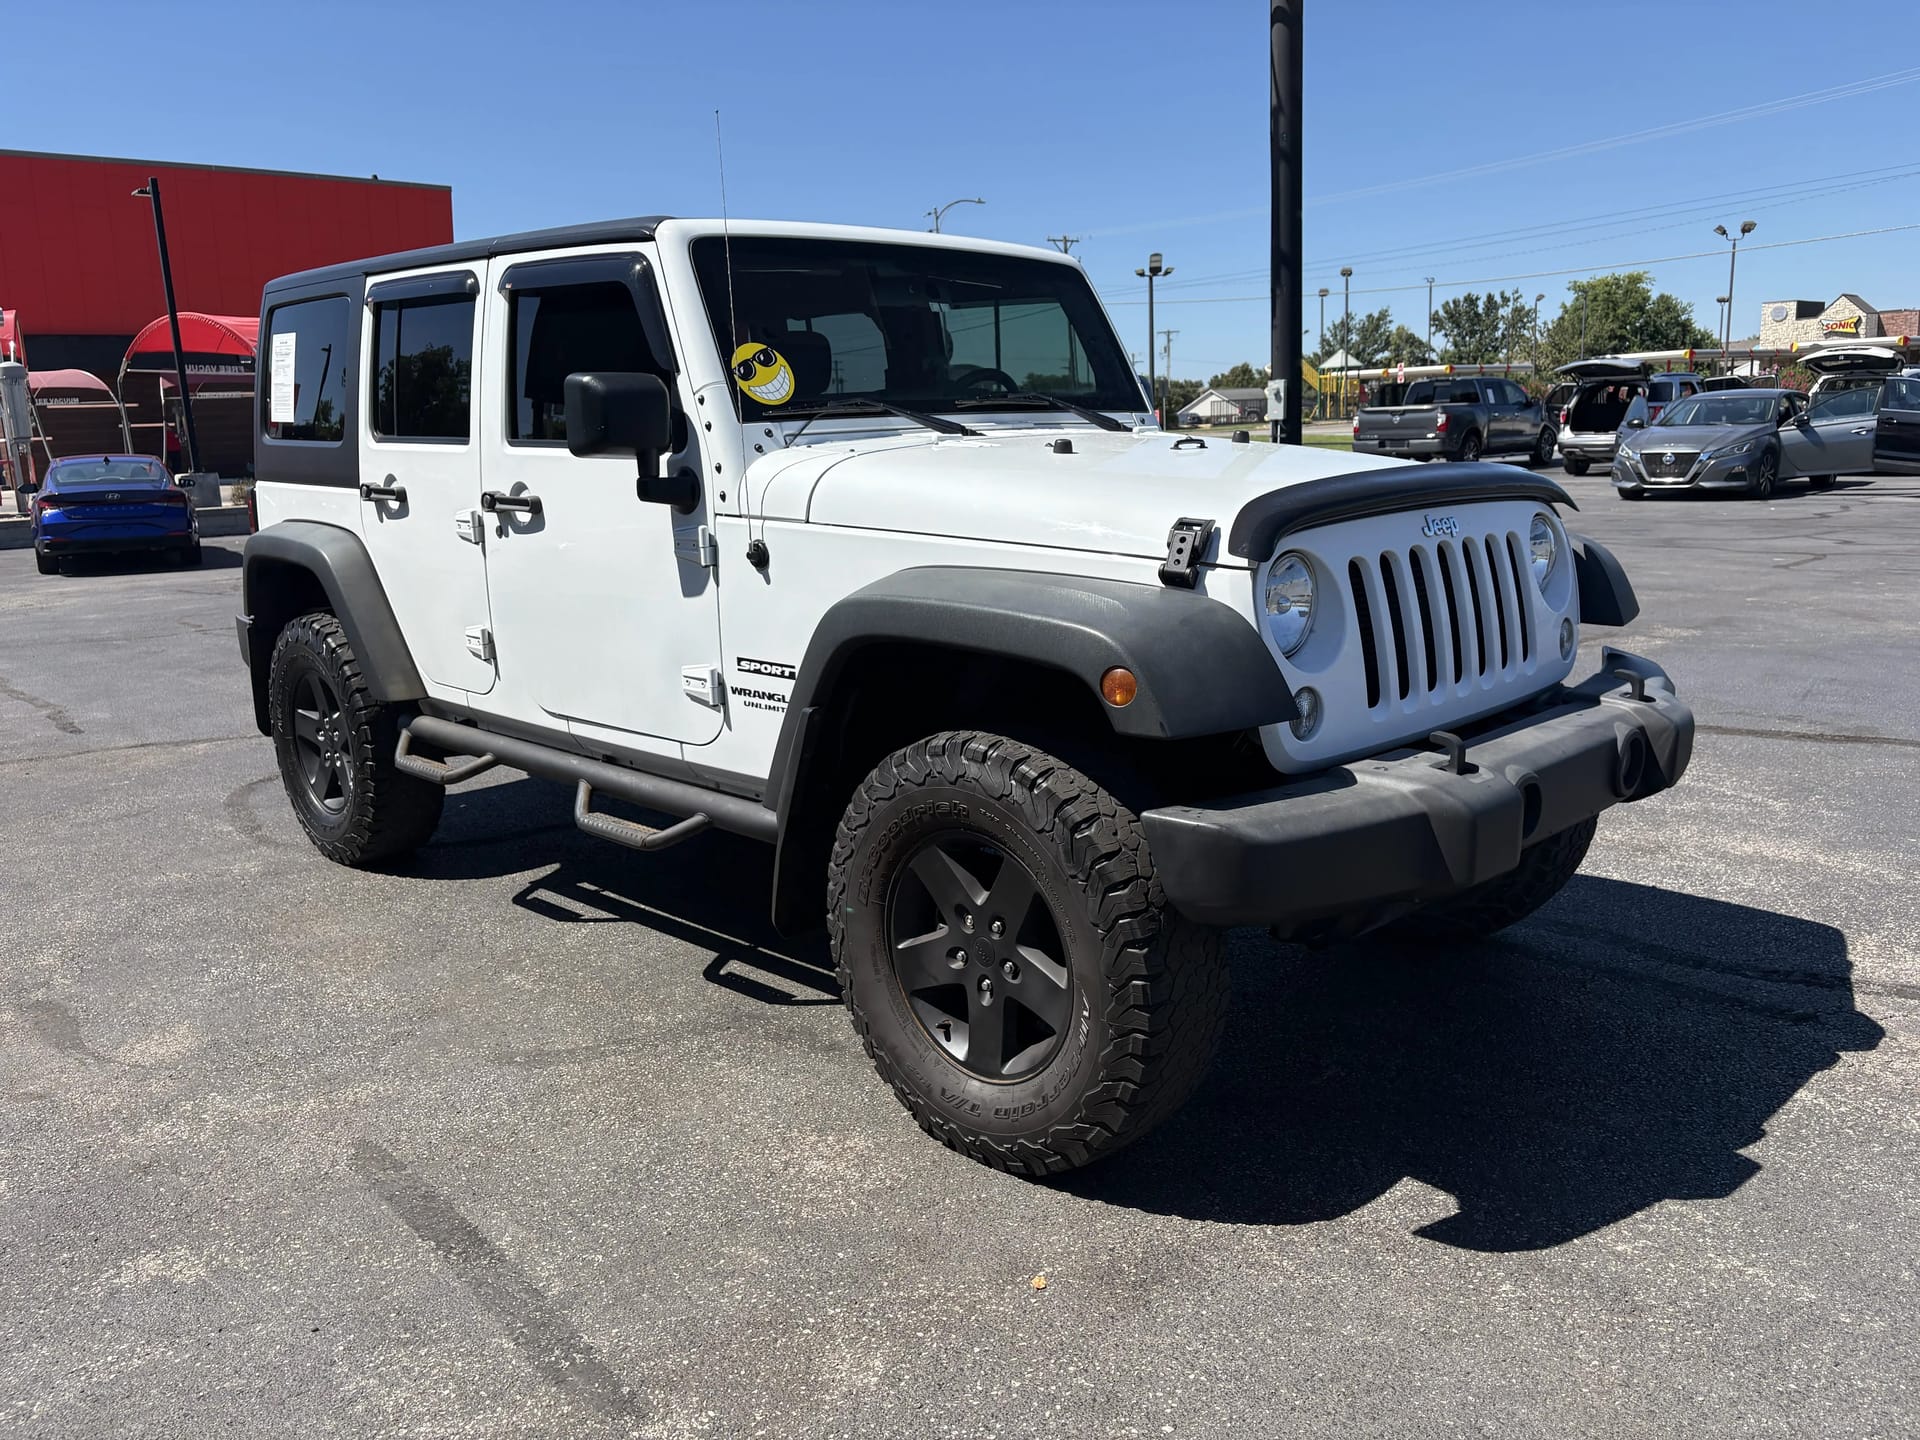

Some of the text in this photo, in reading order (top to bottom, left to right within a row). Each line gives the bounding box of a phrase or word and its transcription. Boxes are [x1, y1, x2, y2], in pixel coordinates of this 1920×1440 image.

[1824, 321, 1854, 330] SONIC
[1421, 513, 1460, 538] Jeep
[739, 660, 792, 677] SPORT
